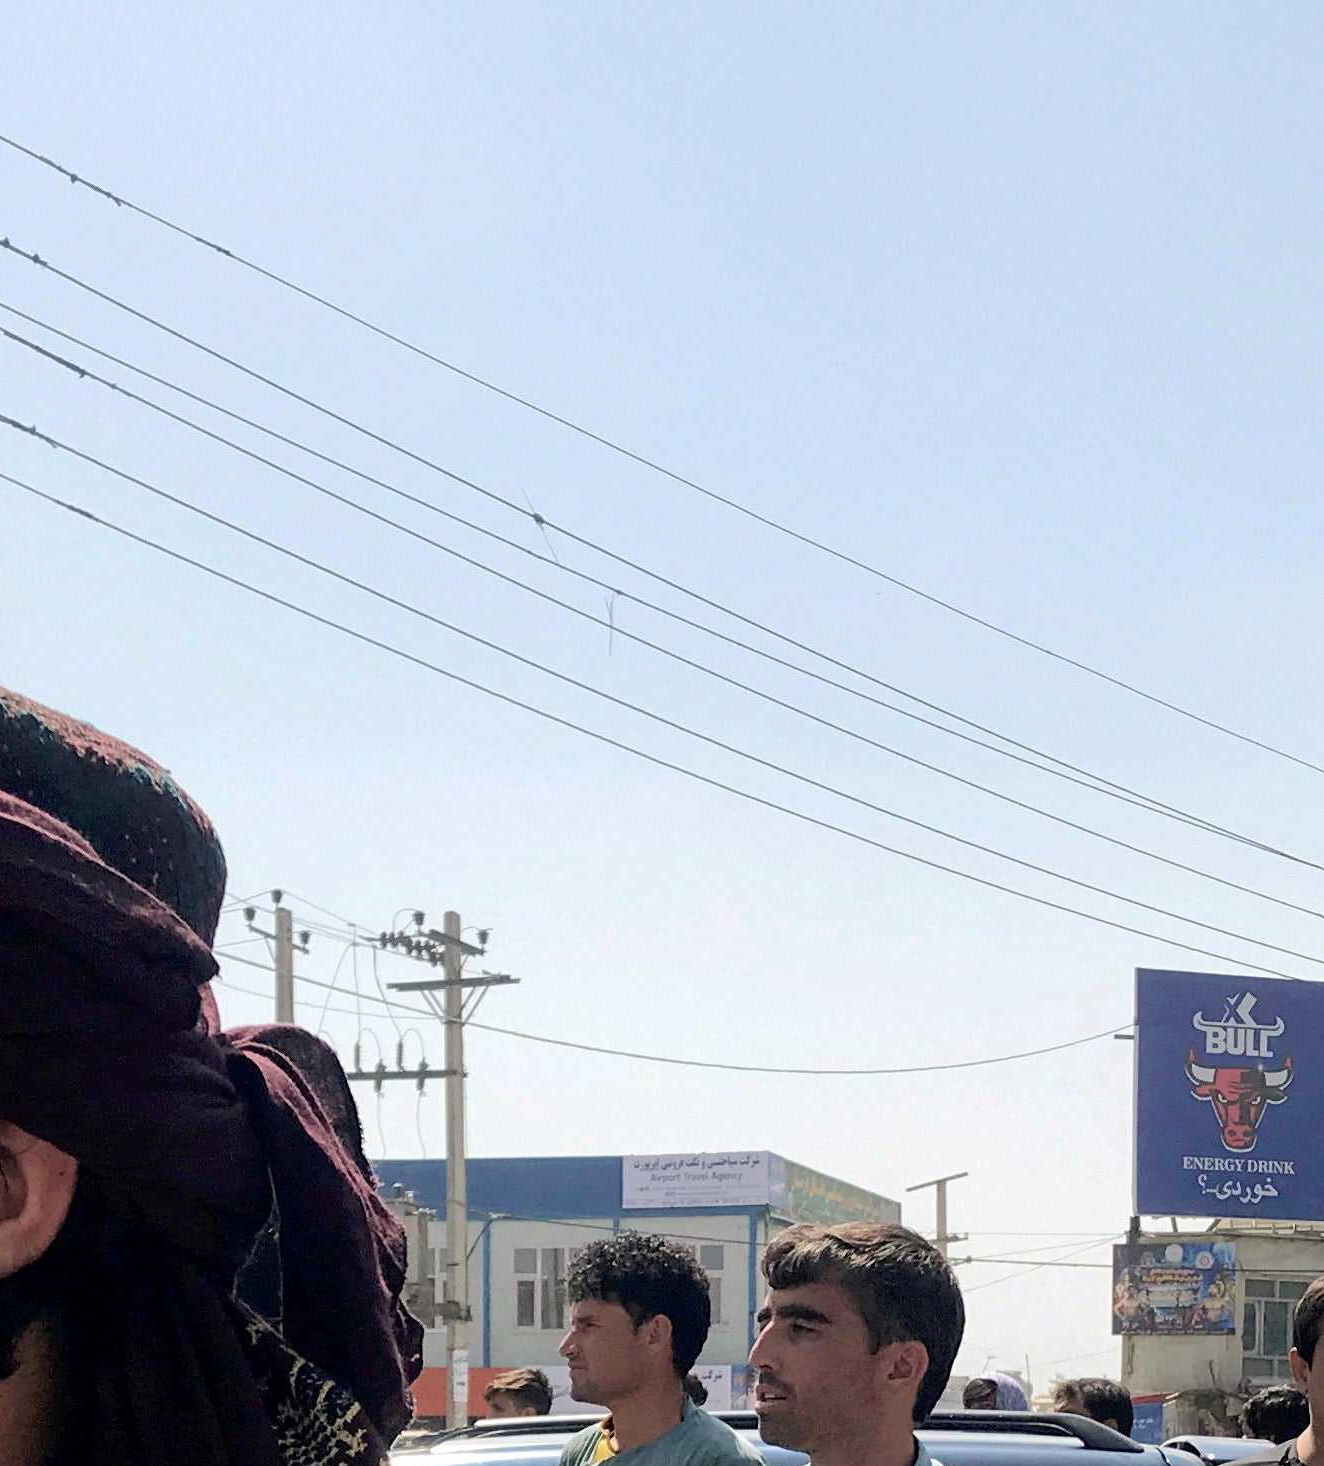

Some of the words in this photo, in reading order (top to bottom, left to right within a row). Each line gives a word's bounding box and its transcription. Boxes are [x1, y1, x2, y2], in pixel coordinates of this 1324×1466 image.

[1198, 1020, 1280, 1058] BULL
[1182, 1156, 1245, 1173] ENERGY
[1247, 1159, 1295, 1175] DRINK
[650, 1173, 681, 1183] Airport
[684, 1172, 709, 1181] Travel
[711, 1172, 743, 1182] Agency
